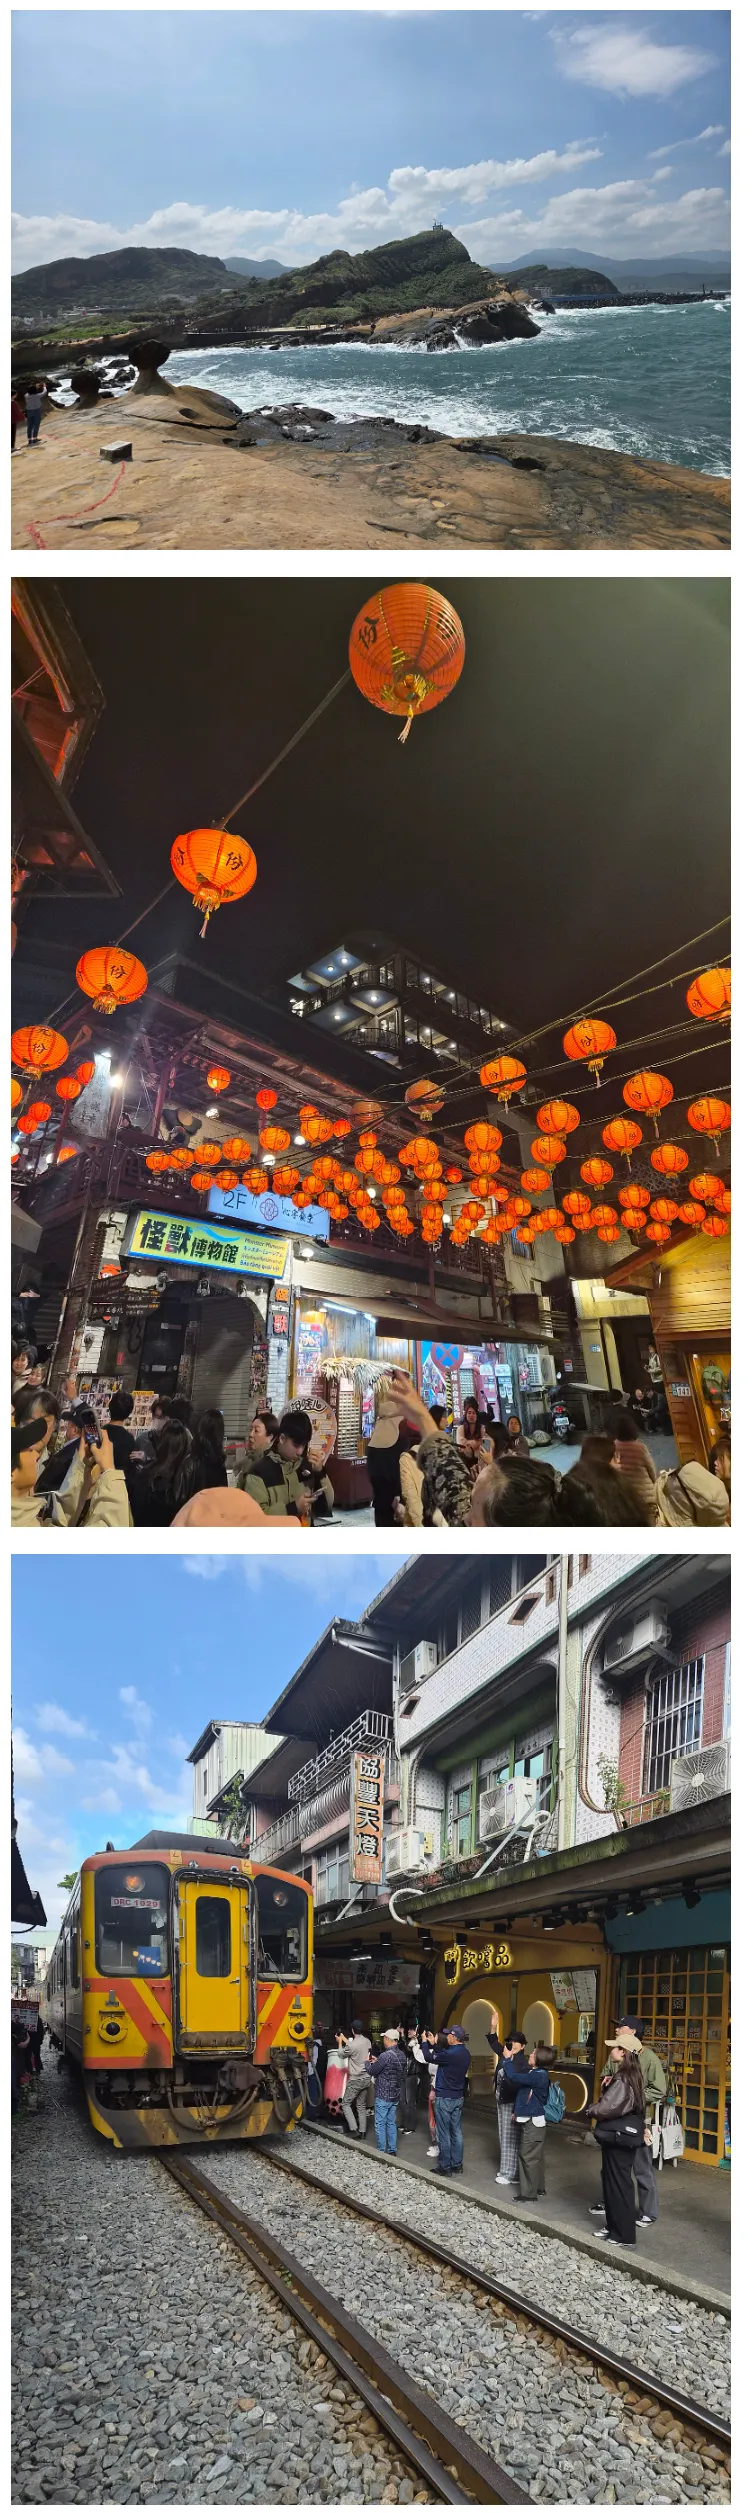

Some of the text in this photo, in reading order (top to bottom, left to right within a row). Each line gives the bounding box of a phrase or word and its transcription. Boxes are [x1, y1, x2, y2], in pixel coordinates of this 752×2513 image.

[223, 1189, 248, 1210] 2F
[140, 1217, 240, 1264] 怪獸博物館
[357, 1756, 380, 1858] 協豐天燈
[113, 1898, 159, 1908] DRC 1029
